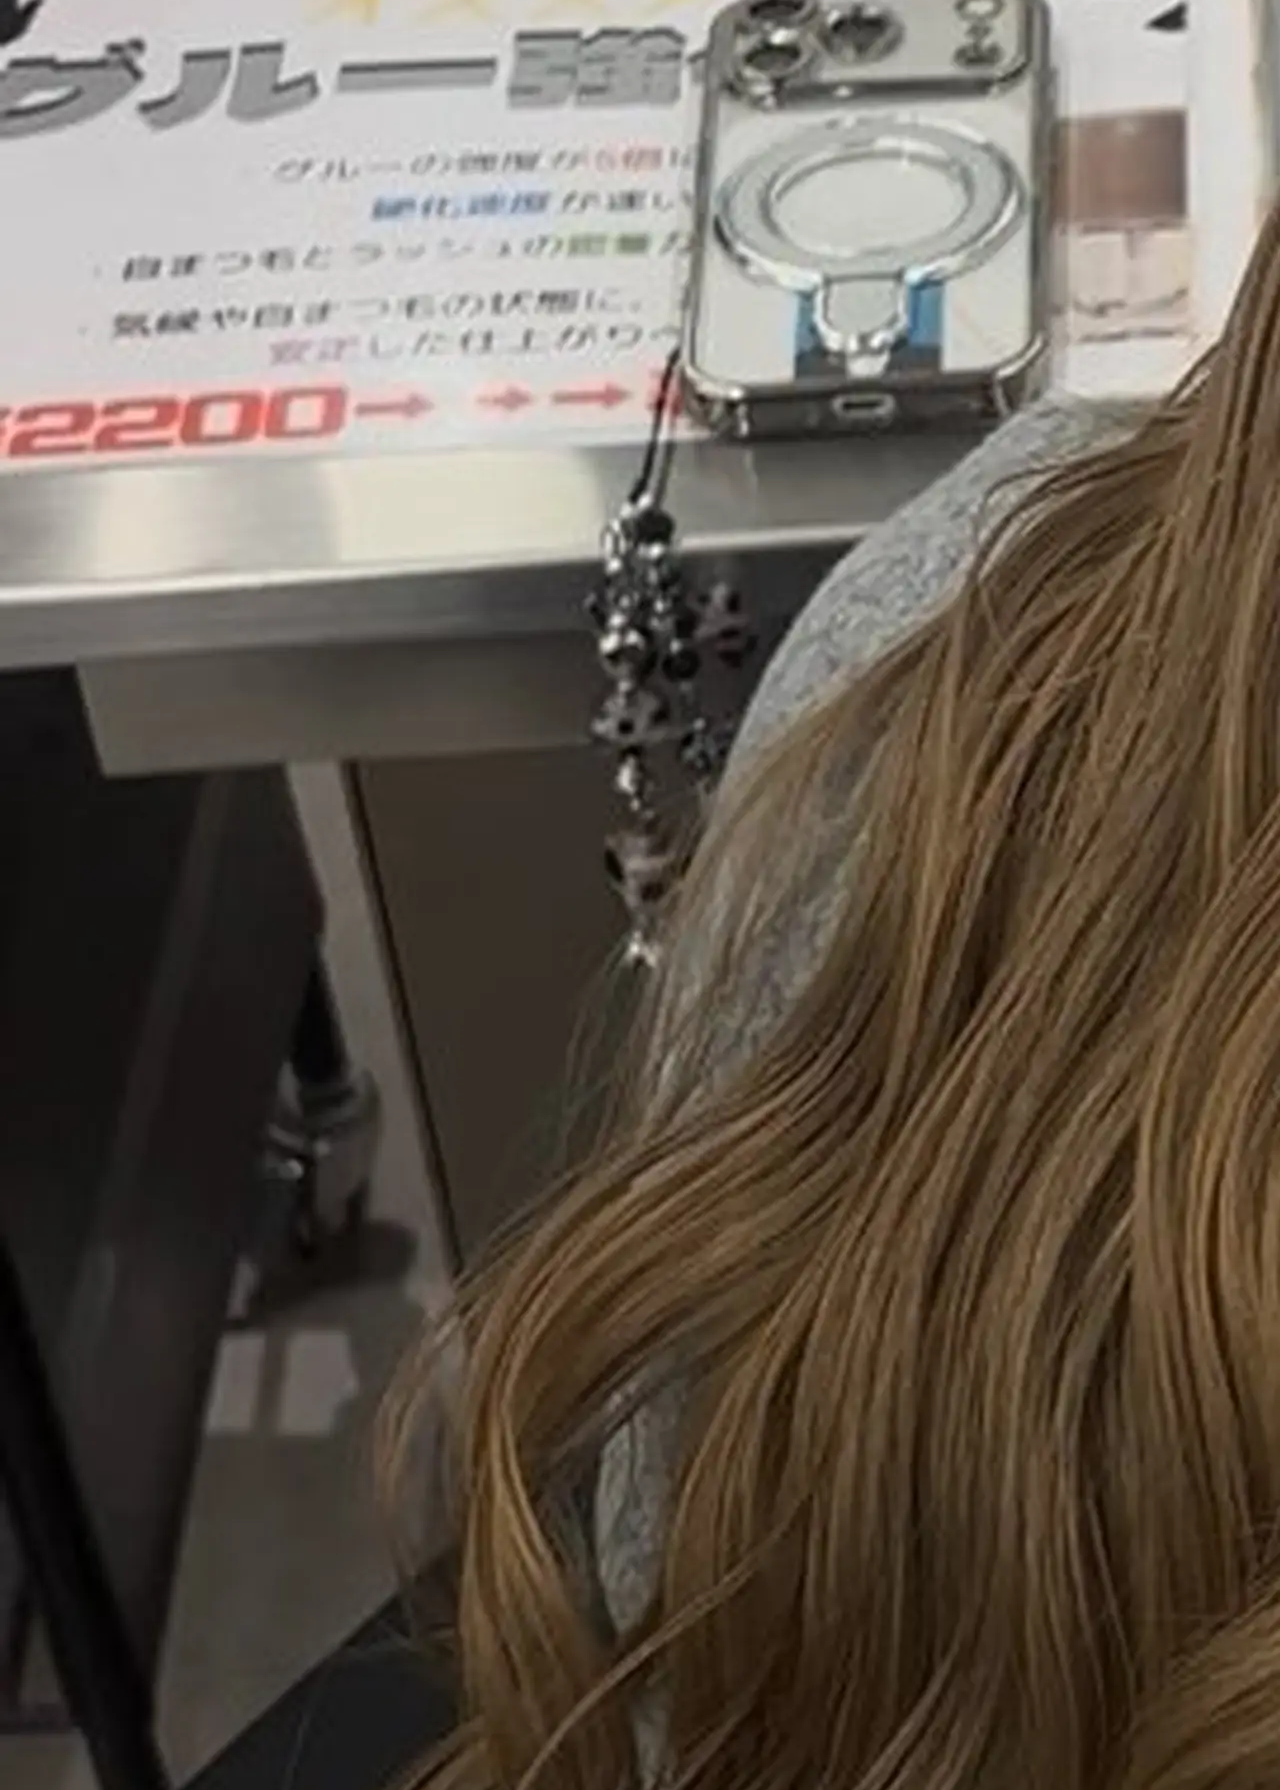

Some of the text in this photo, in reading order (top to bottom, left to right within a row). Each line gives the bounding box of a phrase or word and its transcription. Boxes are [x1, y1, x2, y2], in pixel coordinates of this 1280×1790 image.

[0, 27, 706, 140] グルー強
[0, 383, 348, 459] 2200
